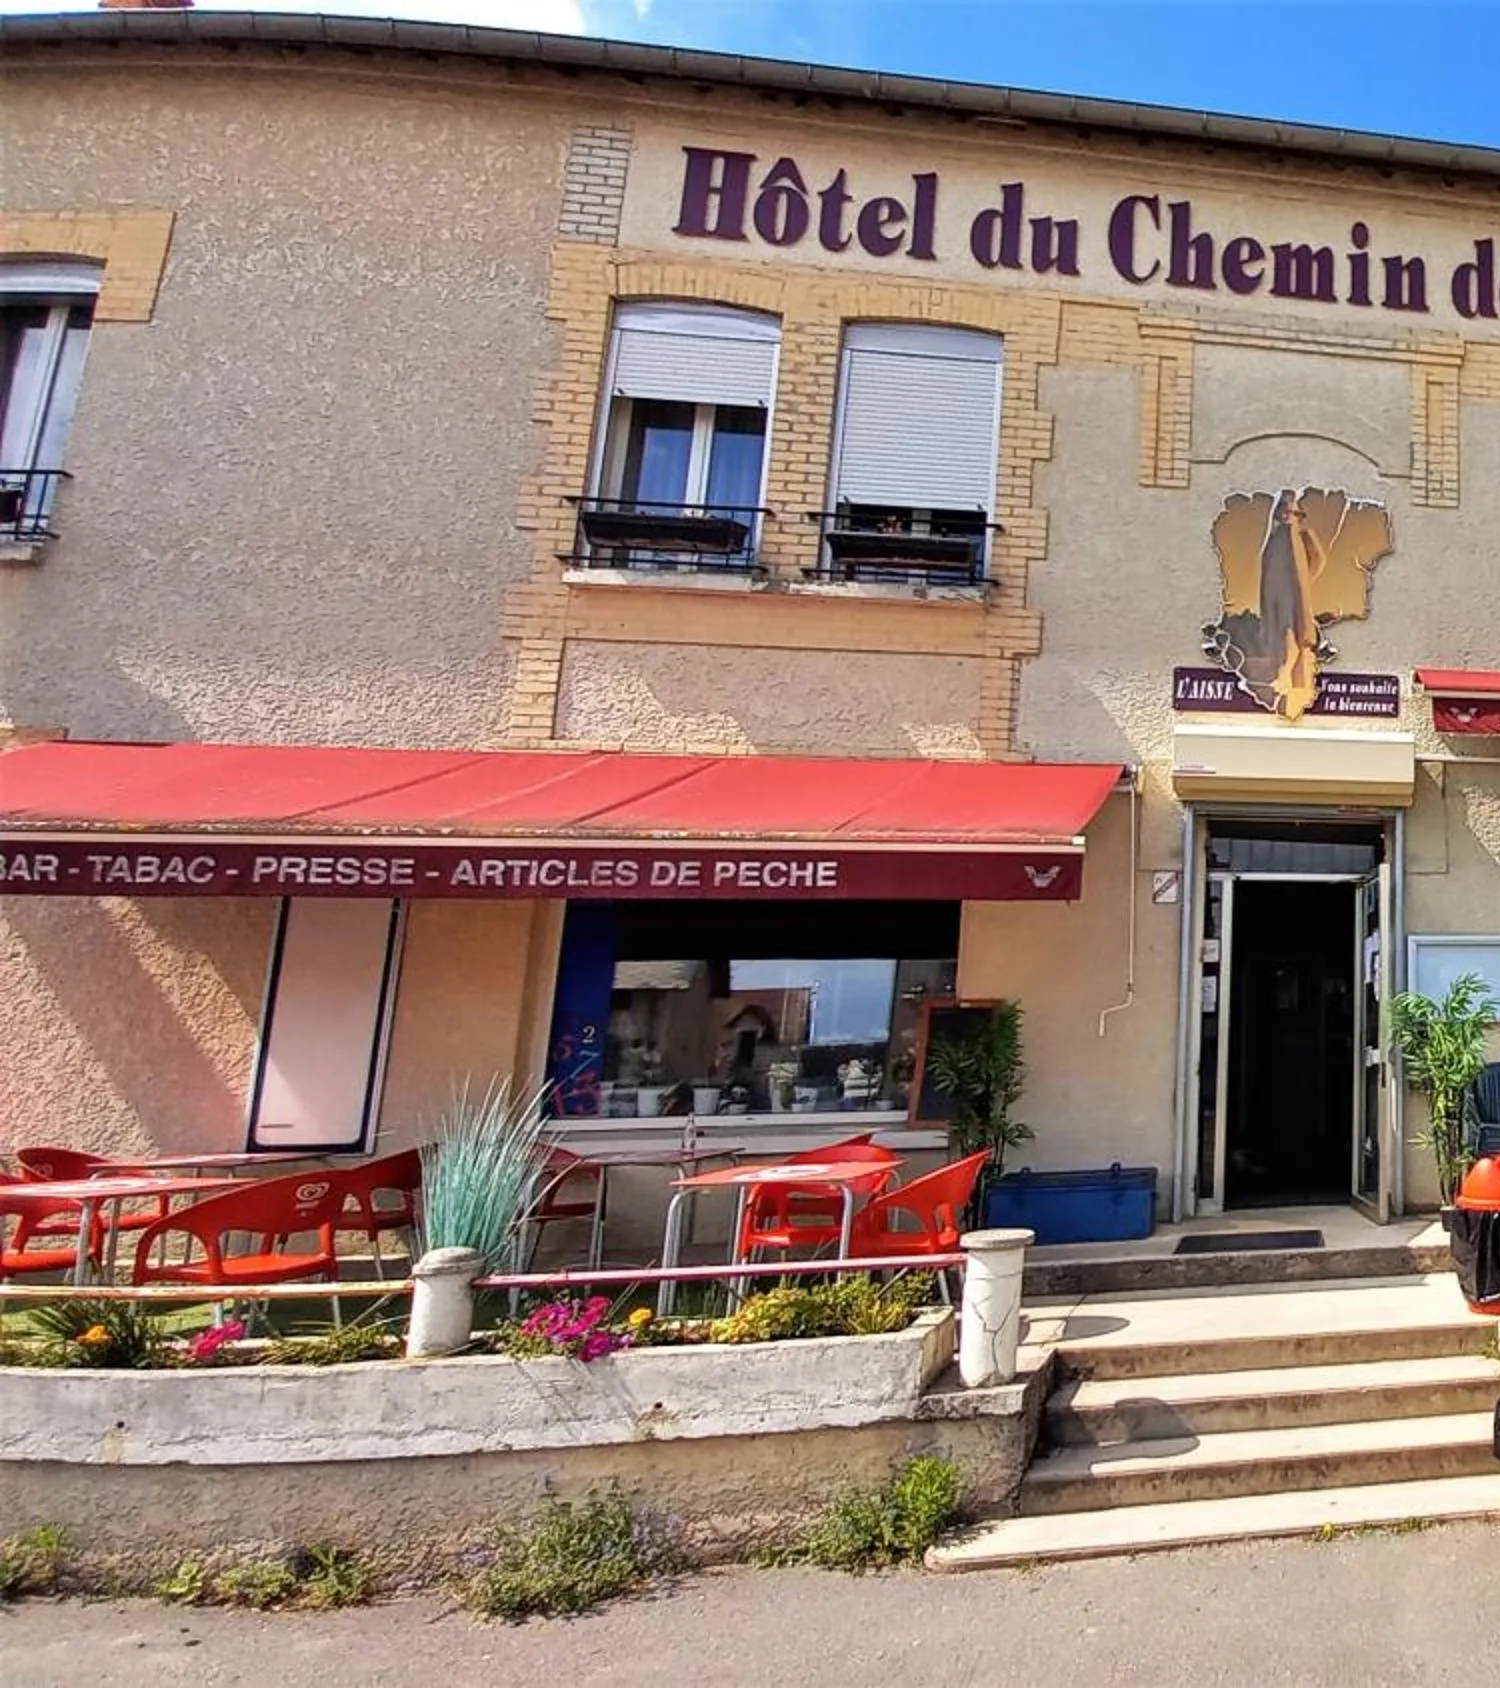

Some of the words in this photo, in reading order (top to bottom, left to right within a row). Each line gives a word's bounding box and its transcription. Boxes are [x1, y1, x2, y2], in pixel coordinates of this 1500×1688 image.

[672, 146, 938, 261] Hôtel
[969, 182, 1081, 277] du
[1108, 193, 1430, 313] Chemin
[86, 855, 216, 883] TABAC
[252, 856, 415, 886] PRESSE
[449, 859, 639, 887] ARTICLES
[650, 861, 702, 887] DE
[713, 860, 838, 888] PECHE
